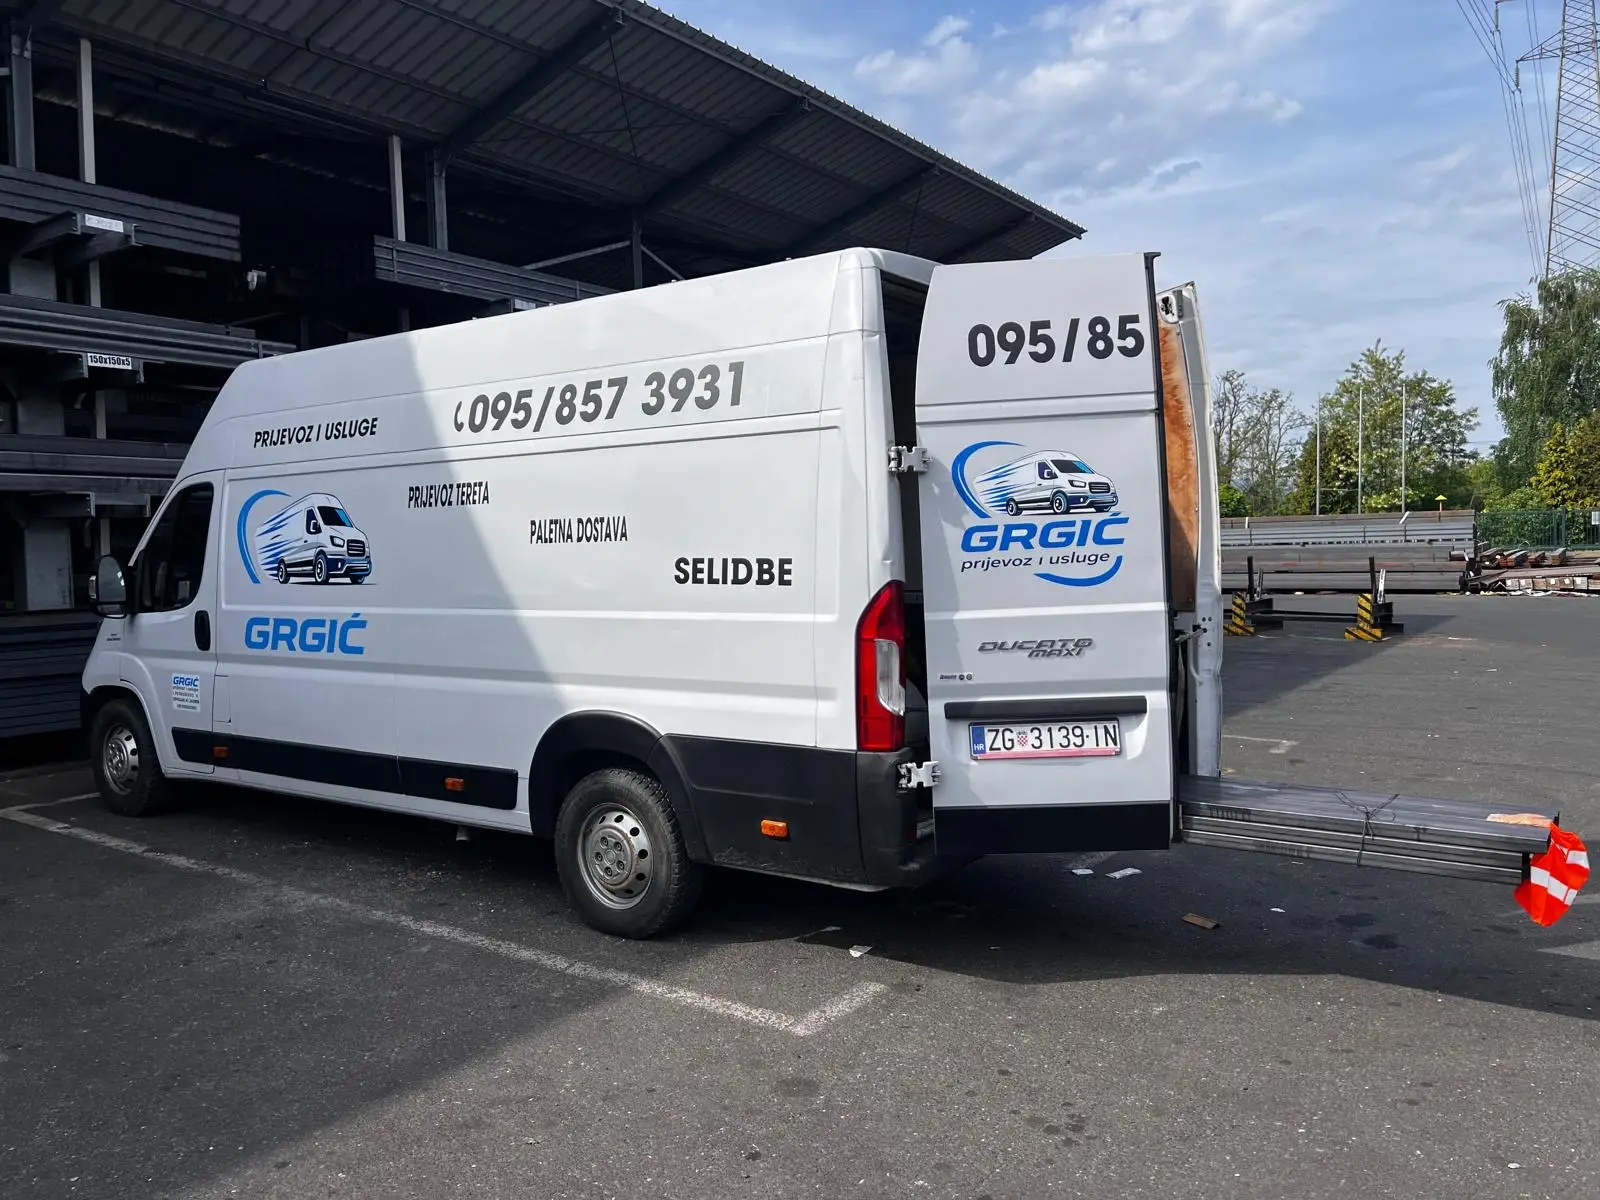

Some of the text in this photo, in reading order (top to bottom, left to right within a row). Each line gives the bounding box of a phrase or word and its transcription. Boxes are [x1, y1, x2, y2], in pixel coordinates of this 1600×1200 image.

[968, 314, 1145, 367] 095/85
[89, 355, 130, 366] 150x150x5
[468, 361, 745, 433] 095/857 3931
[253, 417, 378, 448] PRIJEVOZ I USLUGE
[408, 481, 490, 508] PRIJEVOZ TERETA
[530, 516, 628, 544] PALETNA DOSTAVA
[961, 512, 1129, 552] GRGIĆ
[674, 557, 793, 586] SELIDBE
[961, 556, 1032, 573] prijevoz
[1049, 552, 1110, 566] usluge
[245, 612, 368, 655] GRGIĆ
[978, 638, 1093, 652] DUCATO
[173, 676, 199, 687] GRGIĆ
[973, 743, 985, 751] HR
[987, 728, 1015, 751] ZG
